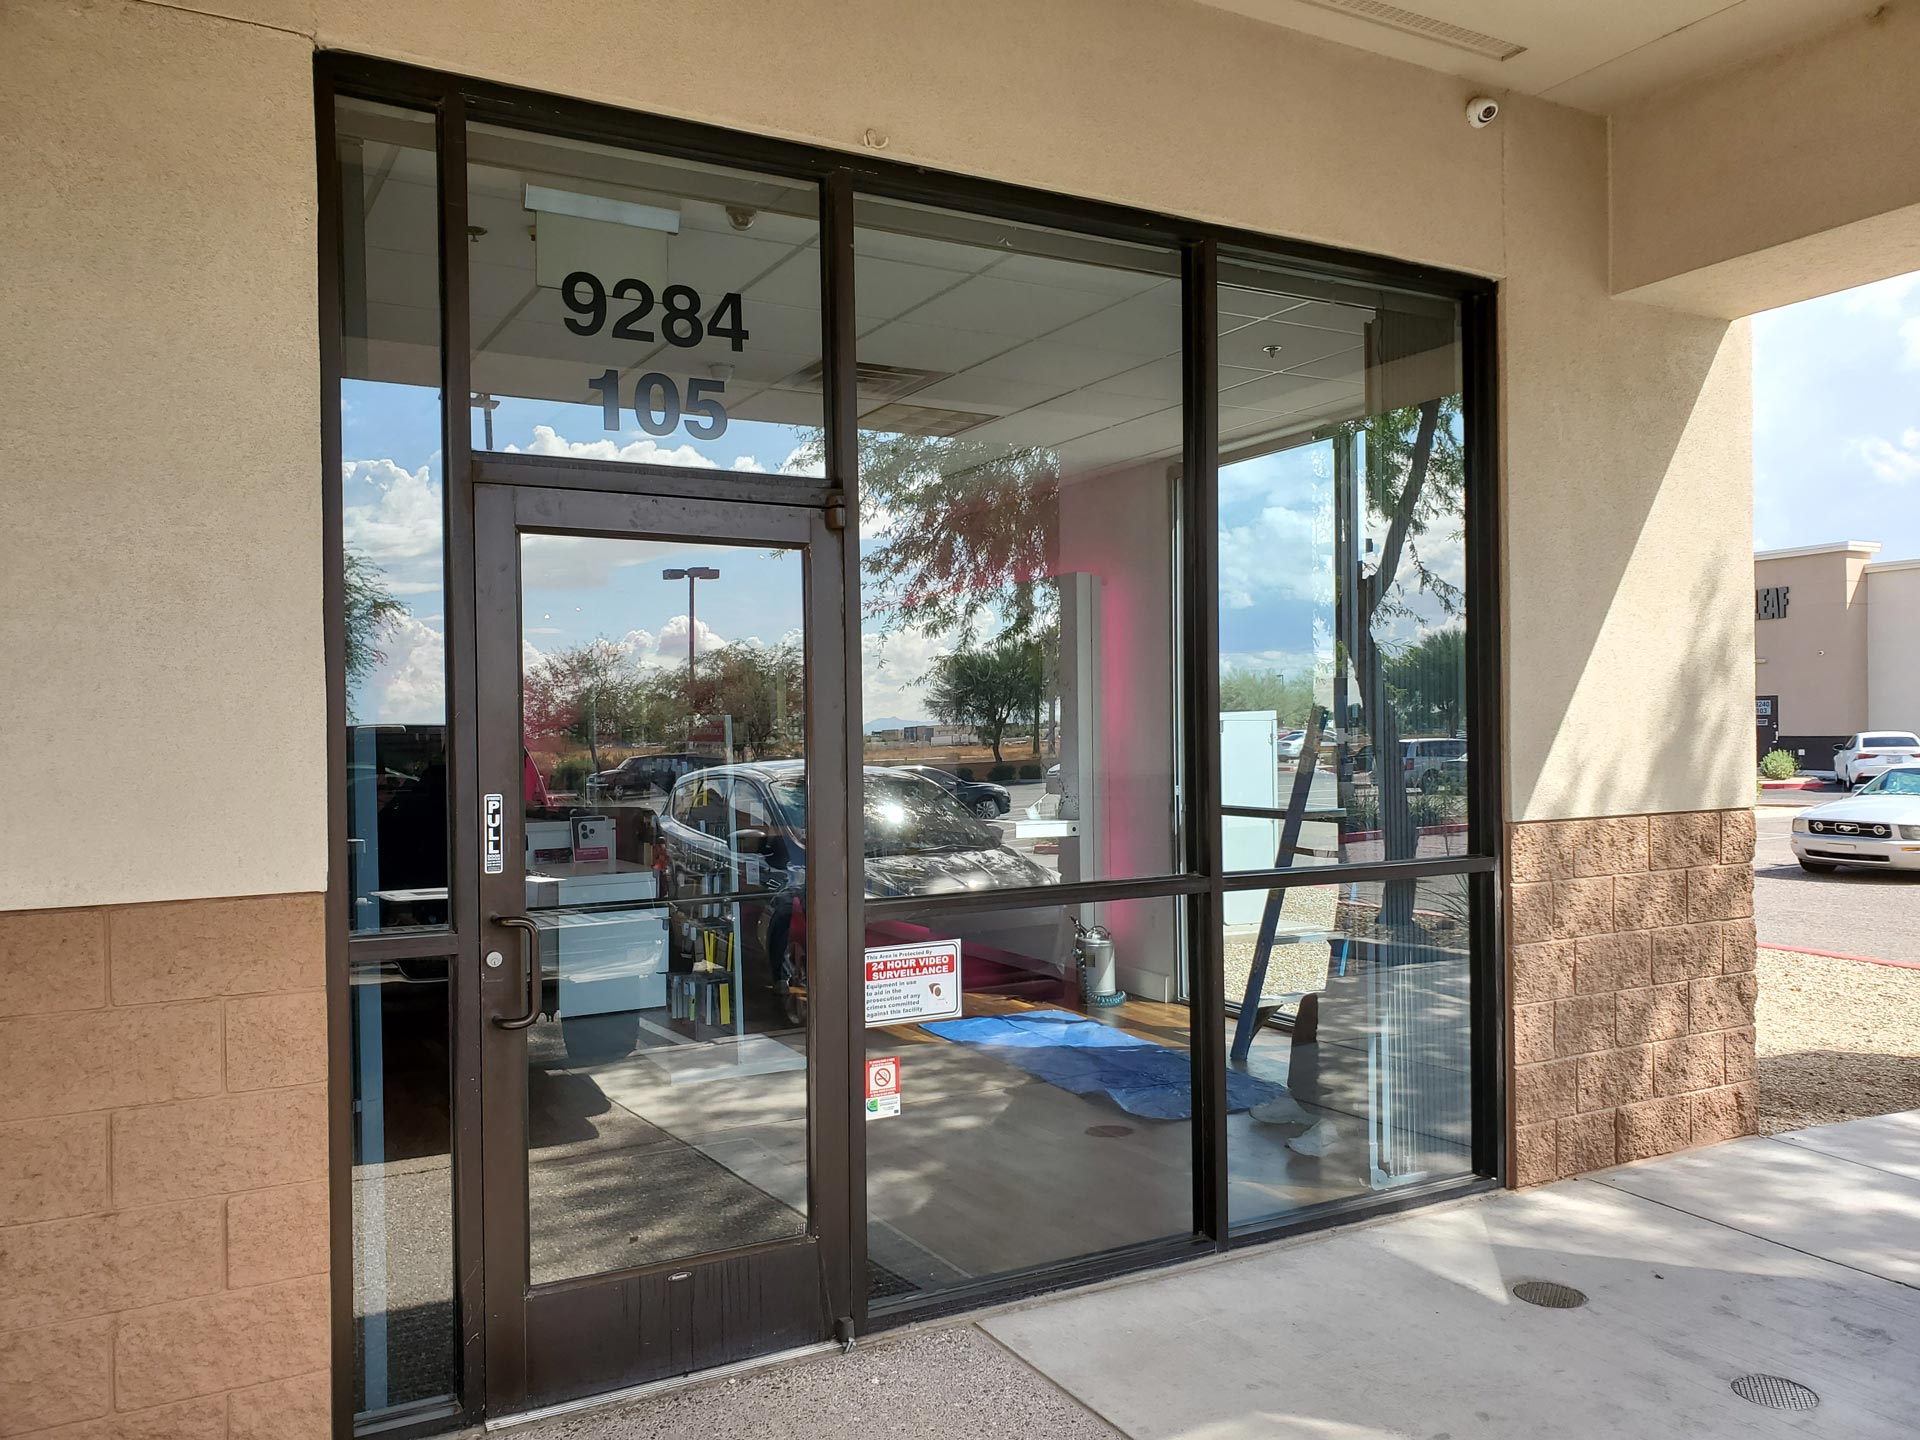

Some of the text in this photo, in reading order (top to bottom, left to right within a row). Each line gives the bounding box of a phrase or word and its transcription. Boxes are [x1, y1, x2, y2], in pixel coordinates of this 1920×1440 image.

[561, 271, 749, 352] 9284
[588, 369, 728, 440] 105
[1756, 586, 1789, 620] EAF
[488, 801, 500, 854] PULL
[899, 949, 924, 957] Protected
[871, 955, 949, 971] 24 HOUR VIDEO
[872, 965, 949, 980] SURVEILLANCE
[866, 981, 898, 990] Equipment
[866, 995, 902, 1004] prosecution
[866, 1010, 889, 1018] against
